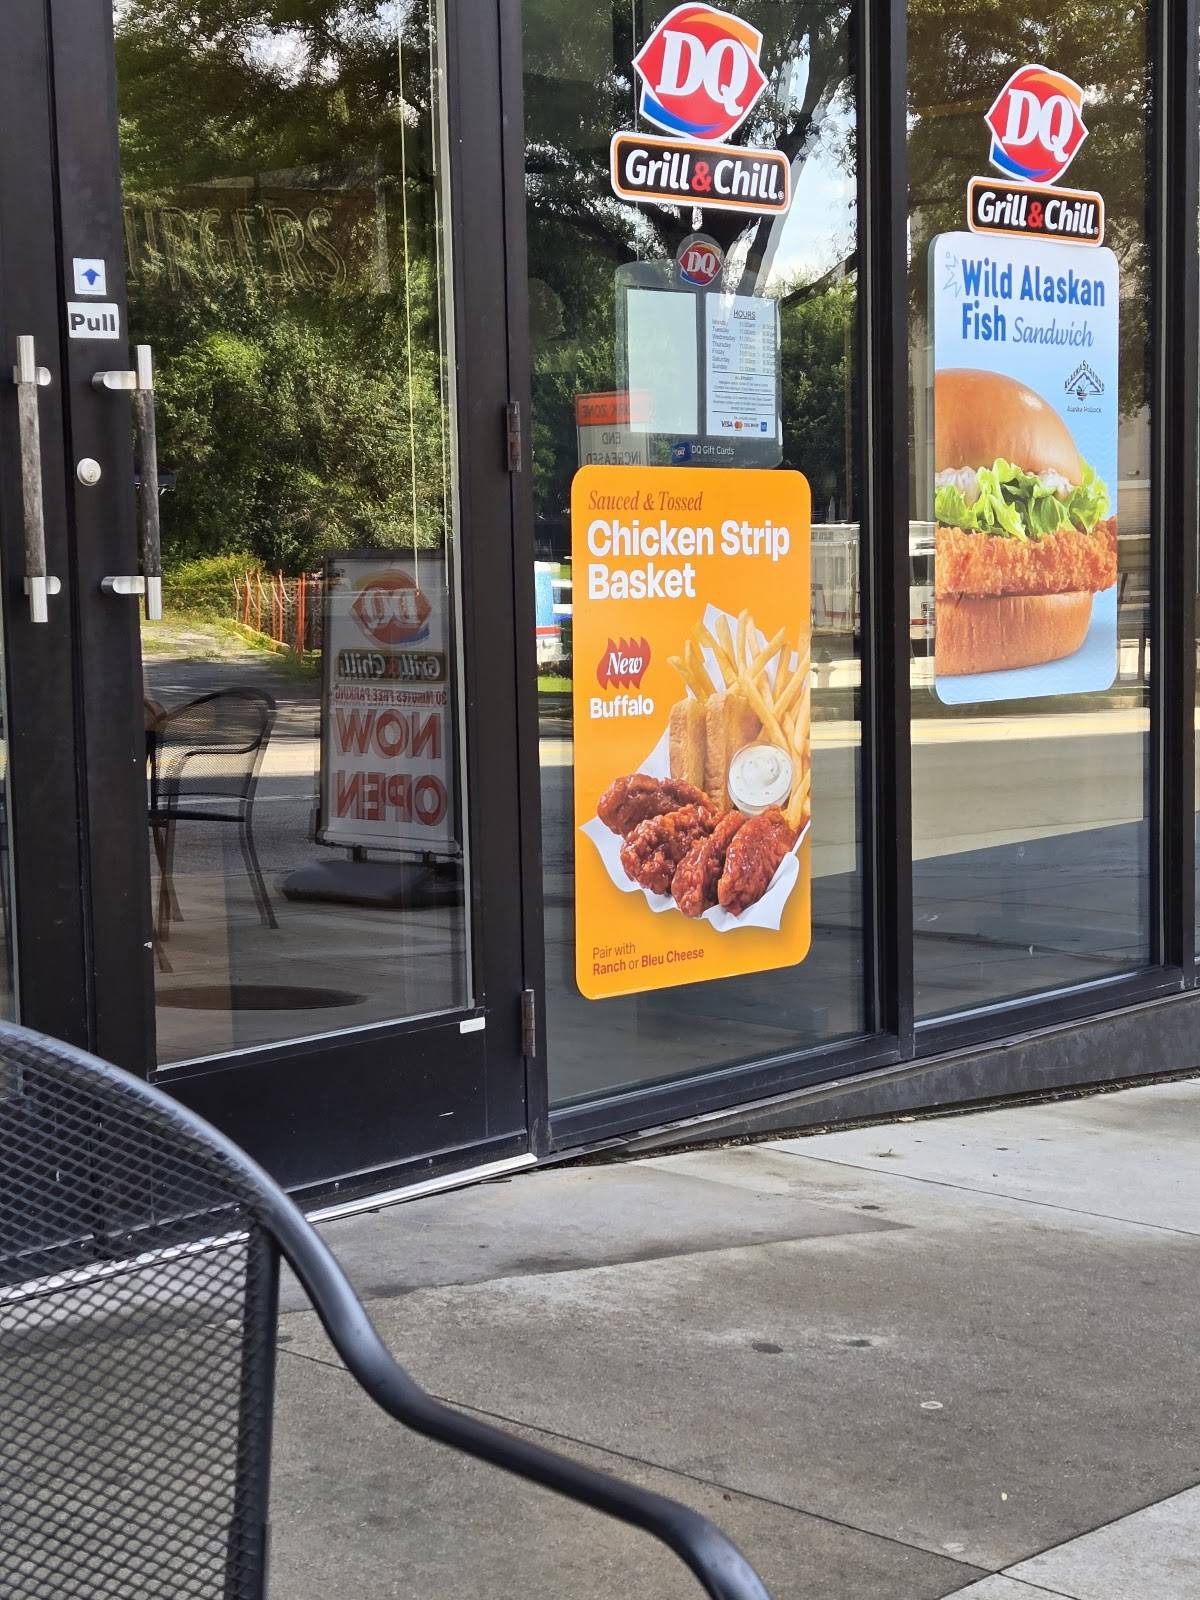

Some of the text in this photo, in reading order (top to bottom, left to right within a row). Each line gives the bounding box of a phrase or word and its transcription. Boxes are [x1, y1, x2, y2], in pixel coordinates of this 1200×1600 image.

[656, 30, 749, 116] DQ
[1001, 88, 1074, 162] DQ
[124, 207, 347, 291] URGERS
[686, 251, 717, 278] DQ
[962, 257, 1105, 307] Wild Alaskan
[70, 313, 116, 331] Pull
[733, 310, 756, 320] HOURS
[962, 300, 1094, 347] Fish Sandwich
[703, 444, 715, 455] Gift
[716, 446, 735, 456] Cards
[588, 490, 703, 511] Sauced & Tossed
[588, 520, 790, 562] Chicken Strip
[588, 562, 696, 600] Basket
[606, 652, 643, 676] New
[590, 694, 654, 718] Buffalo
[592, 942, 636, 960] Pair with
[593, 948, 705, 976] Ranch or Bleu Cheese
